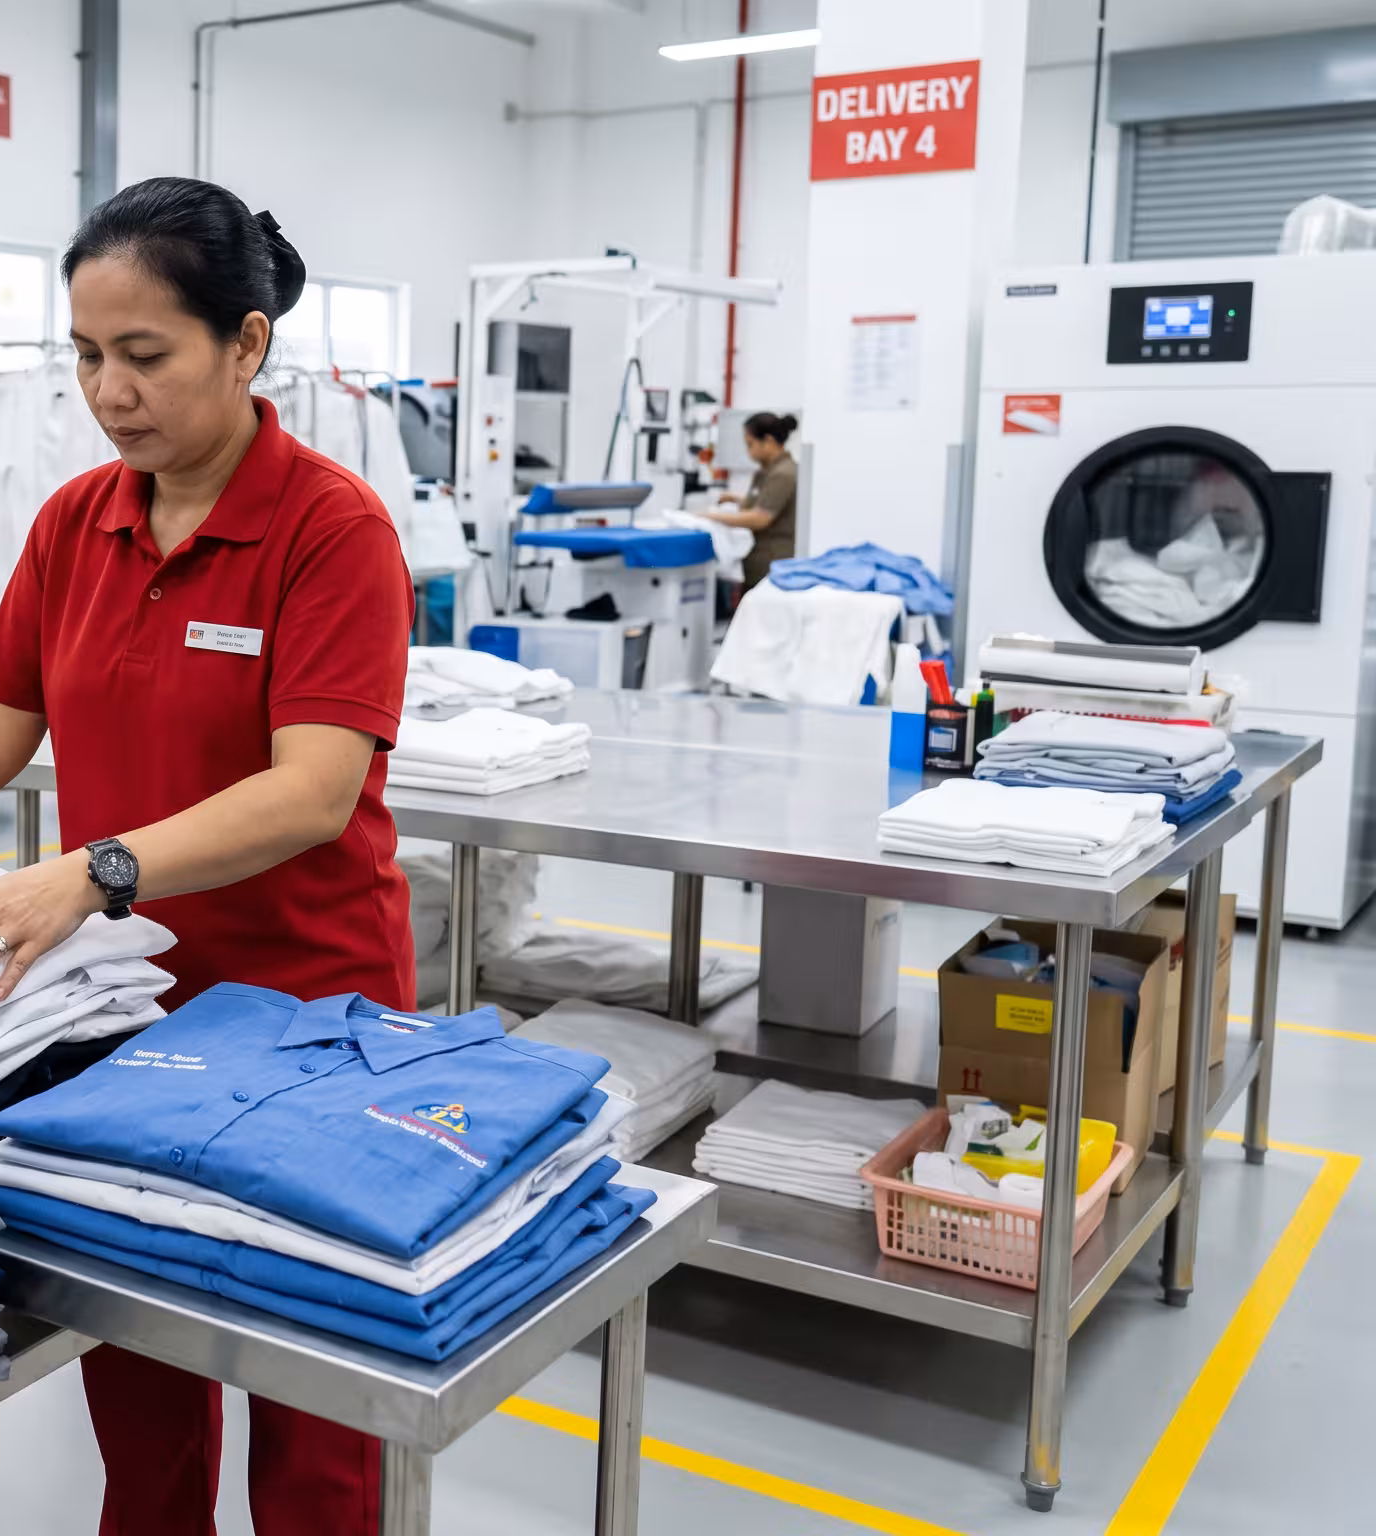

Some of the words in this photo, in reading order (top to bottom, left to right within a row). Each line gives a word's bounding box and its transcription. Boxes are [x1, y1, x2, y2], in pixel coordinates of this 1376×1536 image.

[817, 75, 972, 122] DELIVERY
[845, 126, 909, 165] BAY
[914, 124, 937, 159] 4
